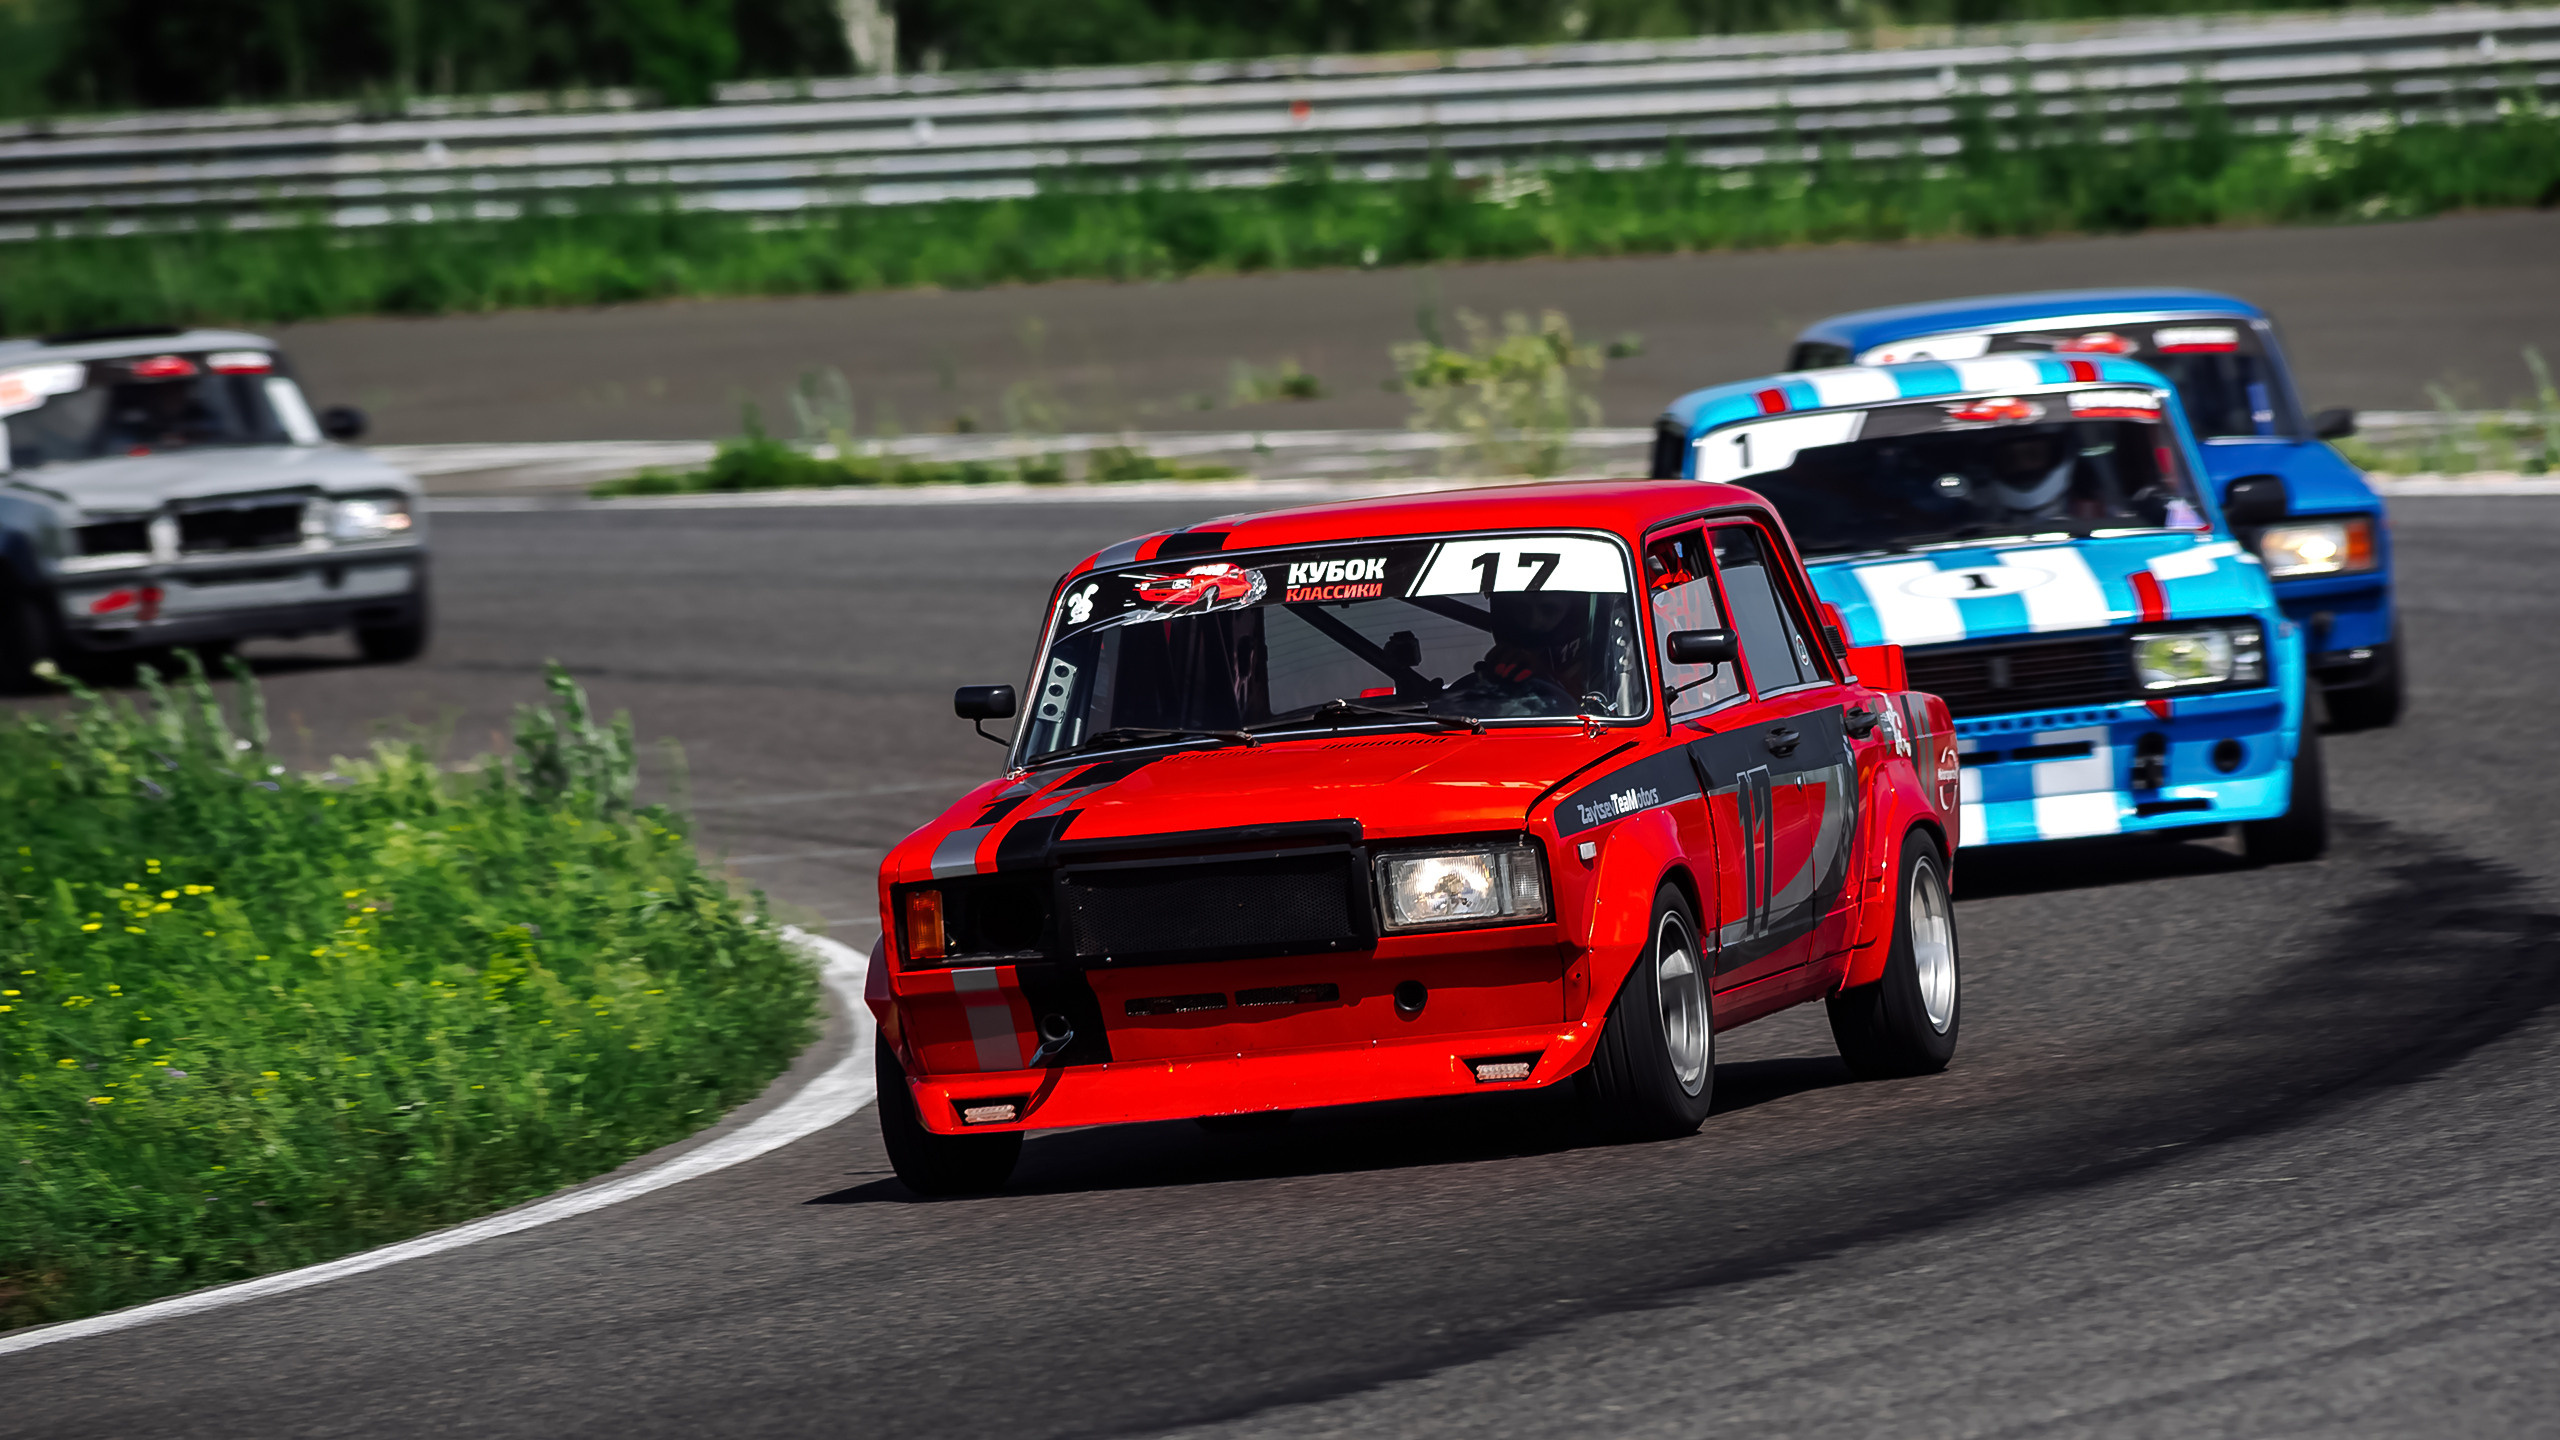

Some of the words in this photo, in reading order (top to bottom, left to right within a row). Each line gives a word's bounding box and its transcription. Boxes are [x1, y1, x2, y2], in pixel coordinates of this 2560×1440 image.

[1730, 432, 1754, 470] 1
[1287, 557, 1388, 585] КУБОК
[1471, 552, 1561, 593] 17
[1961, 573, 1998, 591] 1
[1286, 583, 1383, 602] КЛАССИКИ
[1577, 787, 1660, 825] ZaytsevTeaMotors
[1737, 764, 1774, 942] 17
